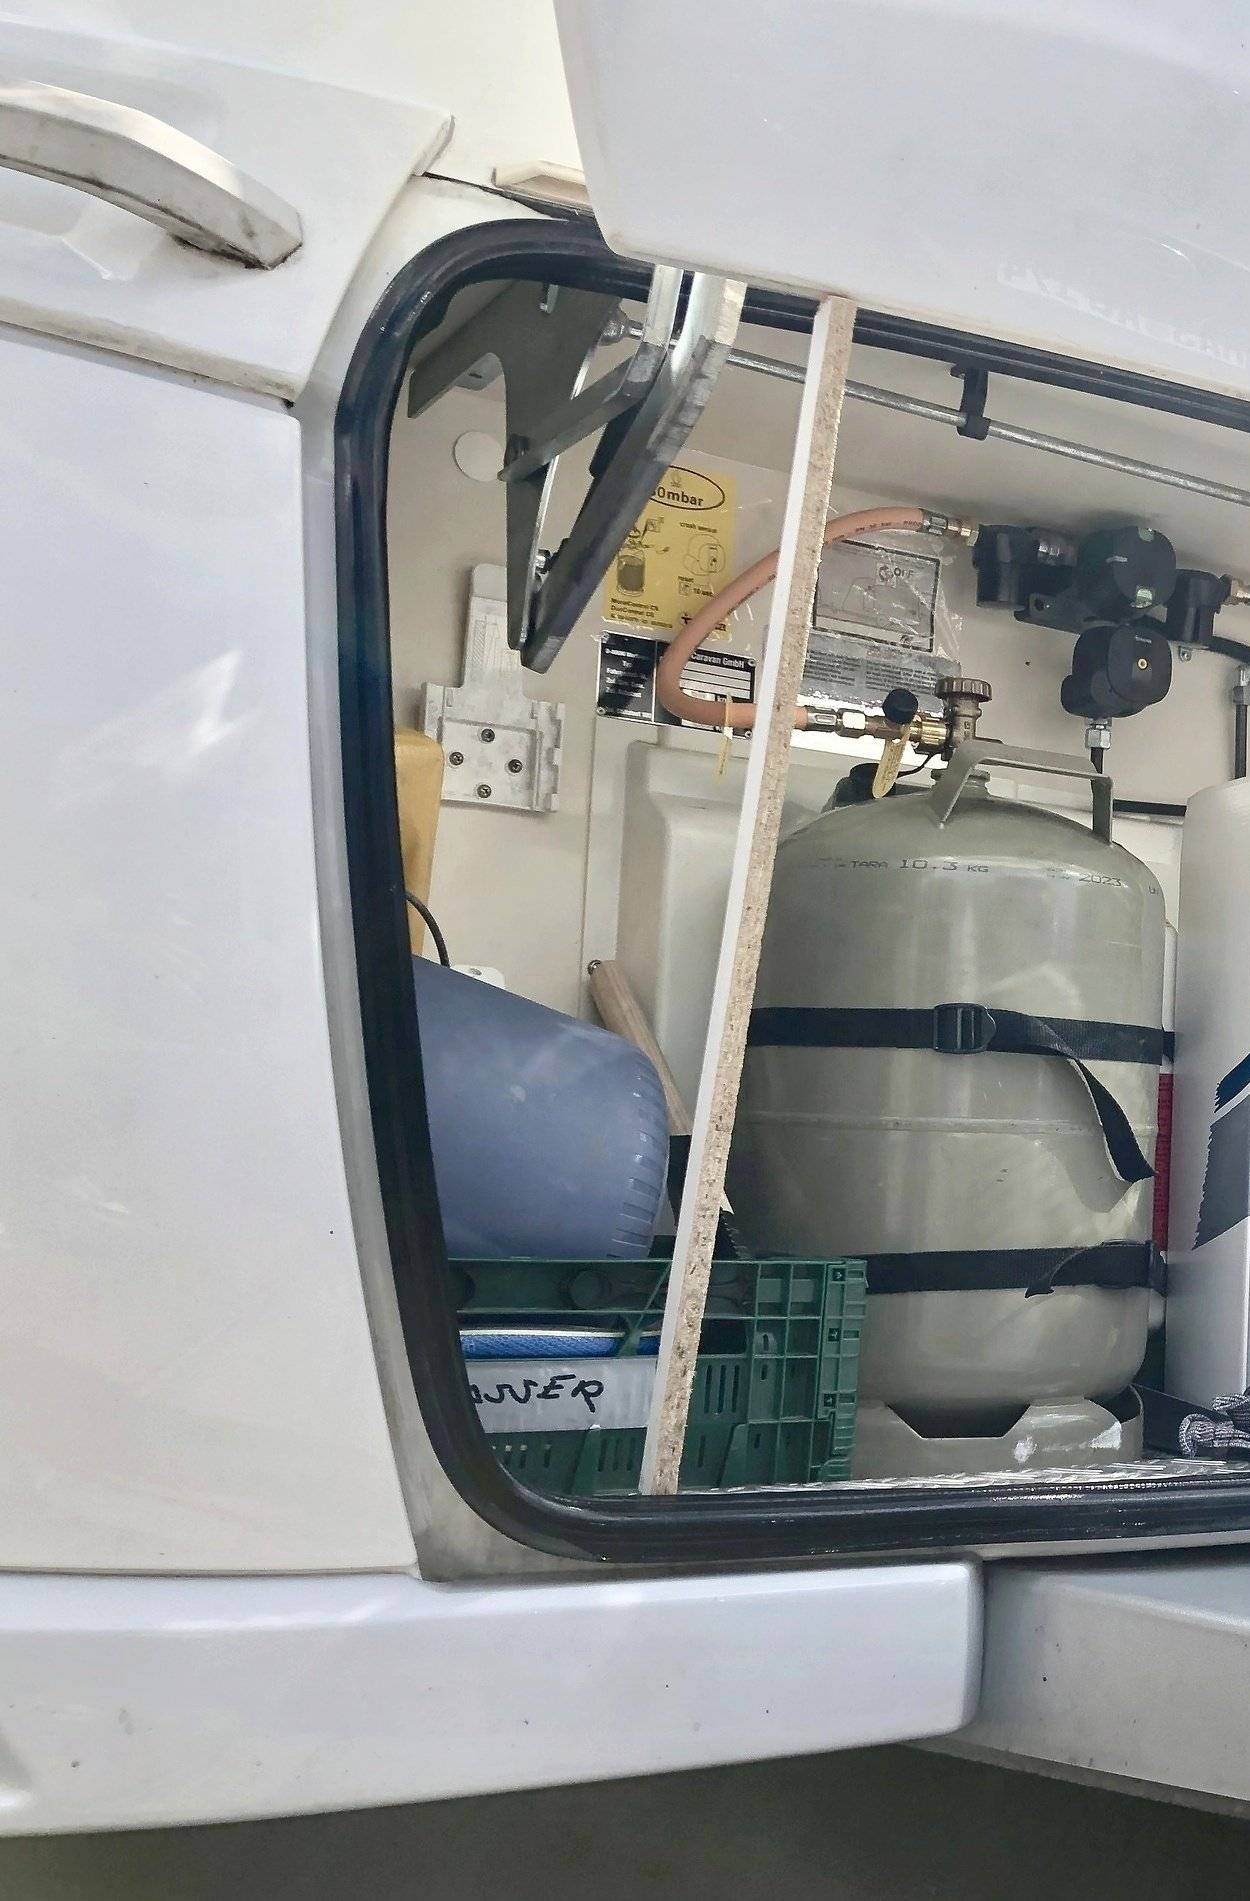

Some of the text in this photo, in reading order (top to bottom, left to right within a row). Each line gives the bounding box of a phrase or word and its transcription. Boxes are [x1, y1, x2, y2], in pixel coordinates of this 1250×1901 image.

[722, 657, 745, 669] GmbH
[967, 864, 990, 874] KG
[1078, 873, 1122, 888] 2023
